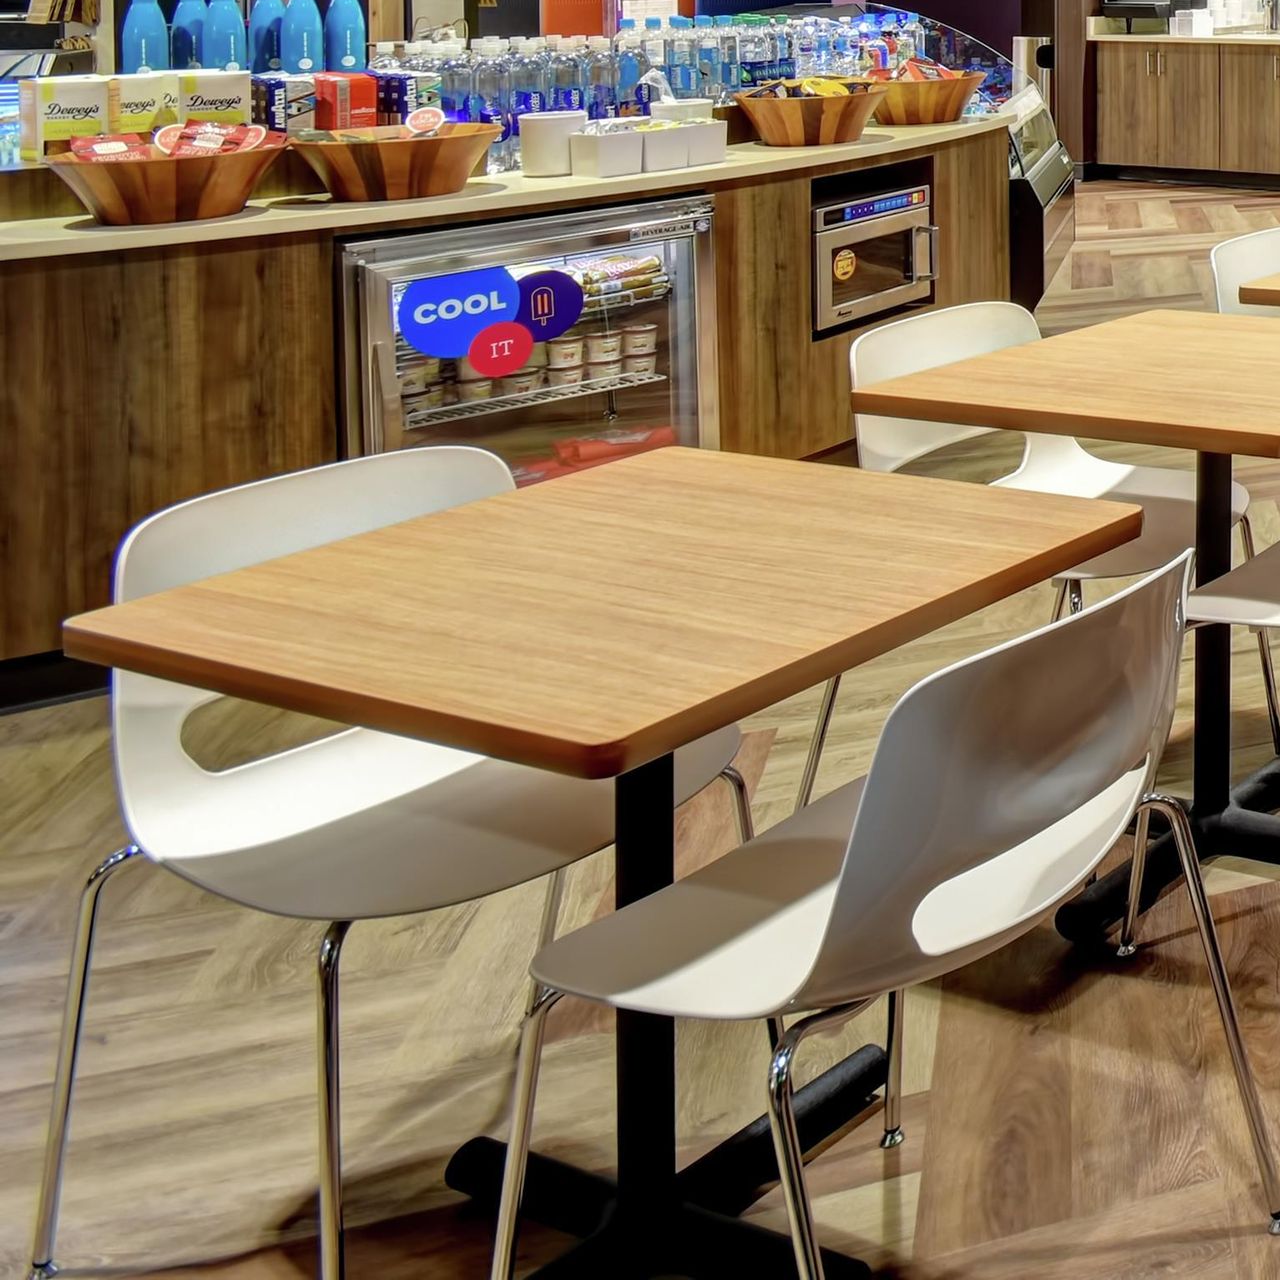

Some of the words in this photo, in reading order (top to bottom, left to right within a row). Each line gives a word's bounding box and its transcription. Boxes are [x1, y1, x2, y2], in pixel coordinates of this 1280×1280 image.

[44, 102, 100, 120] Dewey's
[120, 97, 156, 115] ewey's
[186, 95, 242, 113] Dewey's
[413, 291, 507, 325] COOL
[490, 339, 514, 359] IT
